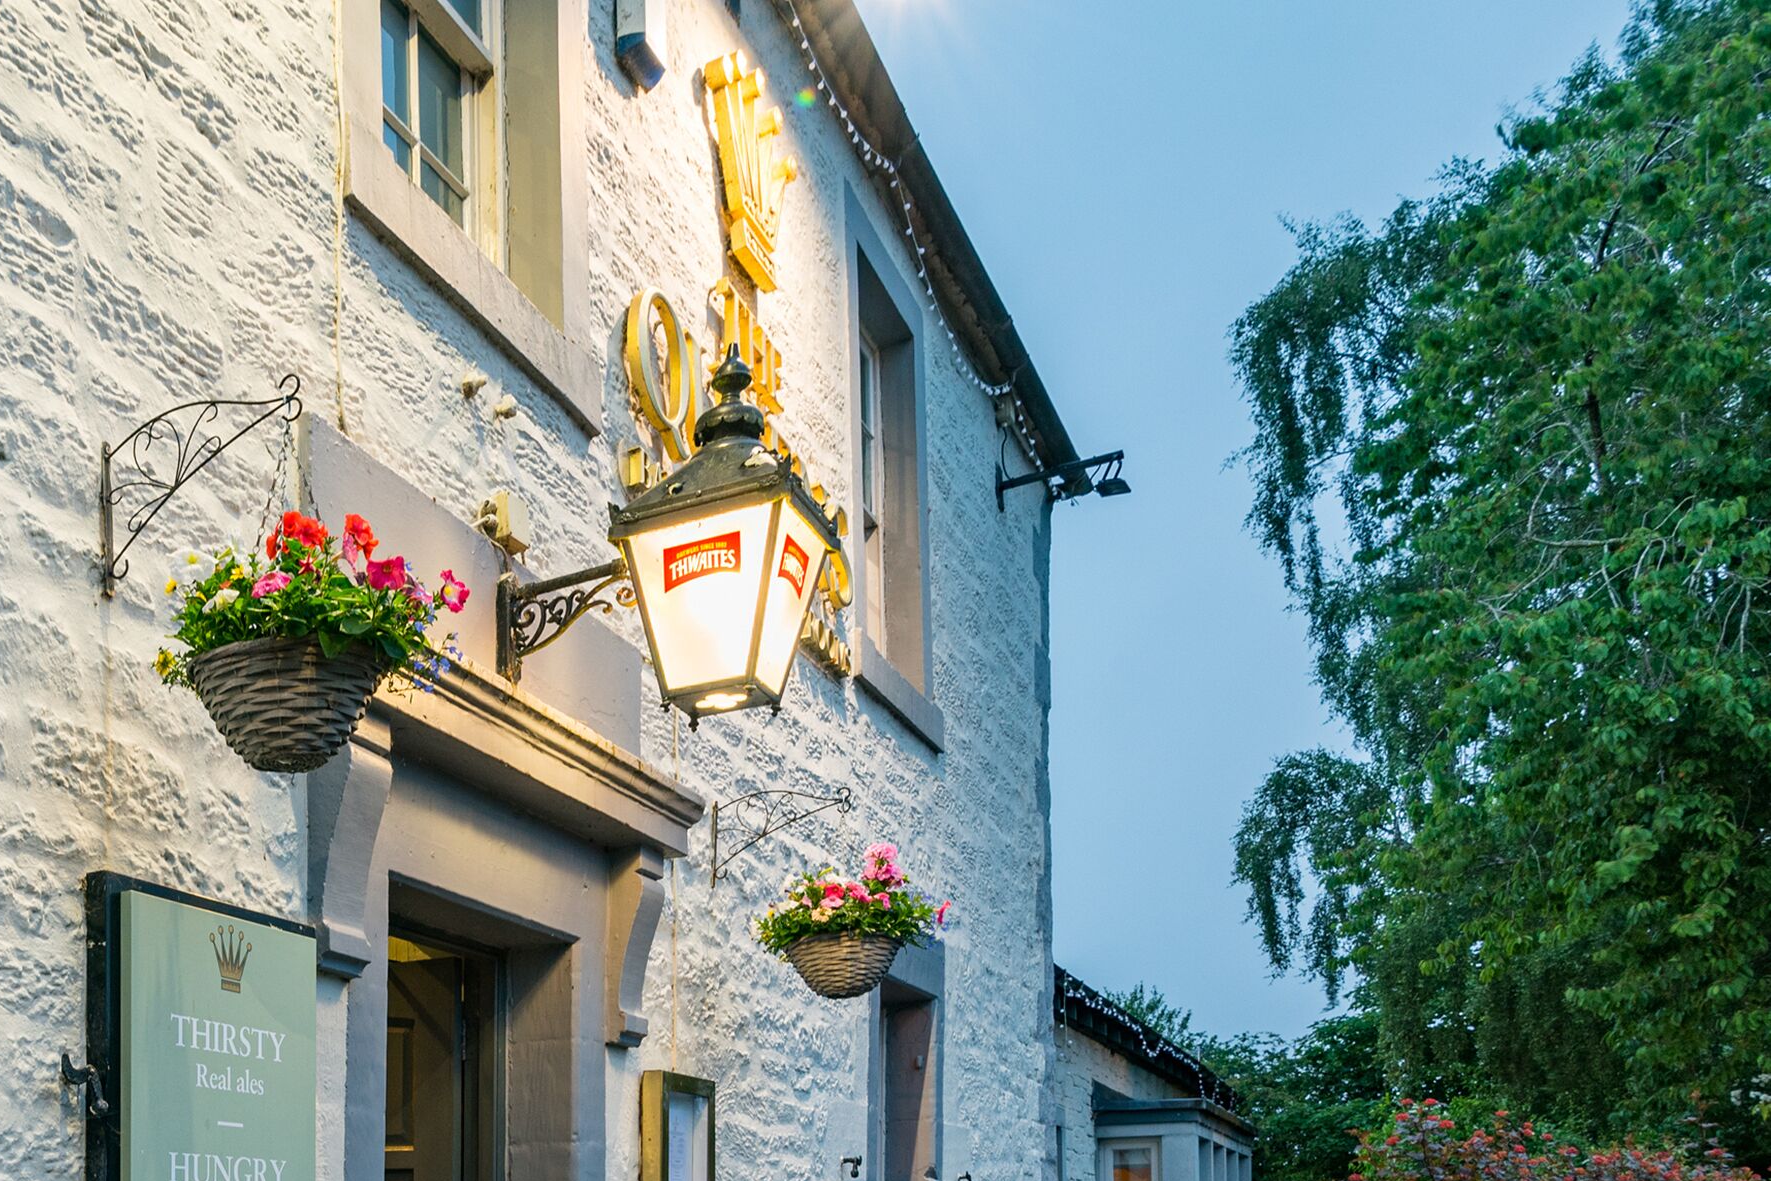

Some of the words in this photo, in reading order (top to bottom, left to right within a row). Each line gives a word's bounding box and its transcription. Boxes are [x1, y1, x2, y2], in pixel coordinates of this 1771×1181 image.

[669, 549, 736, 581] THWAITES
[171, 1013, 286, 1062] THIRSTY
[196, 1063, 231, 1091] Real
[236, 1069, 265, 1096] ales
